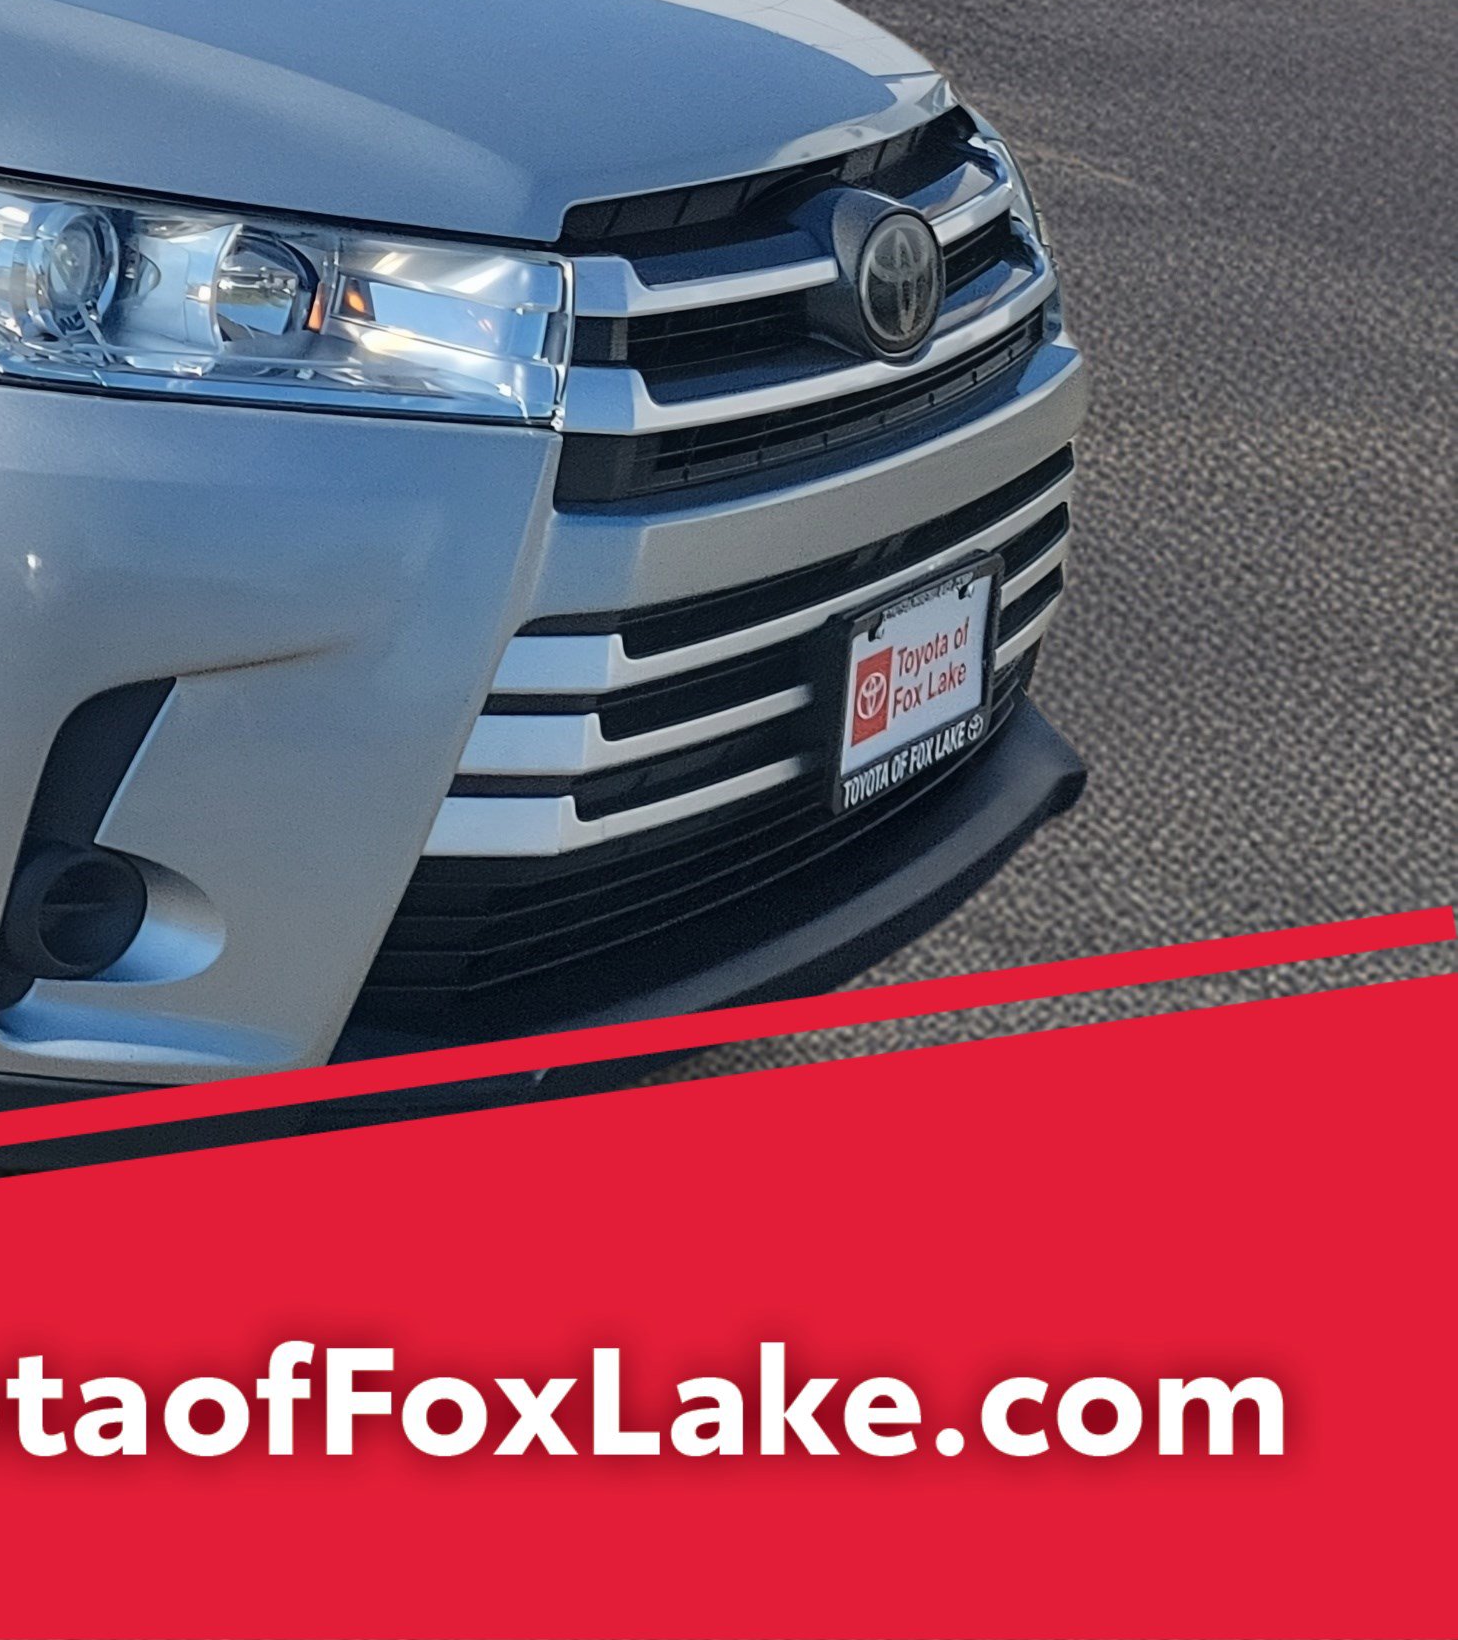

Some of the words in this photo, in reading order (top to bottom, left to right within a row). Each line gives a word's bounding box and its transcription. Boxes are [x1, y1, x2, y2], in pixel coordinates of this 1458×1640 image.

[897, 632, 948, 678] Toyota
[954, 615, 970, 650] of
[891, 682, 923, 720] Fox
[927, 660, 967, 701] Lake
[843, 760, 889, 809] TOYOTA
[891, 749, 908, 784] OF
[908, 736, 934, 774] FOX
[934, 720, 966, 761] LAKE
